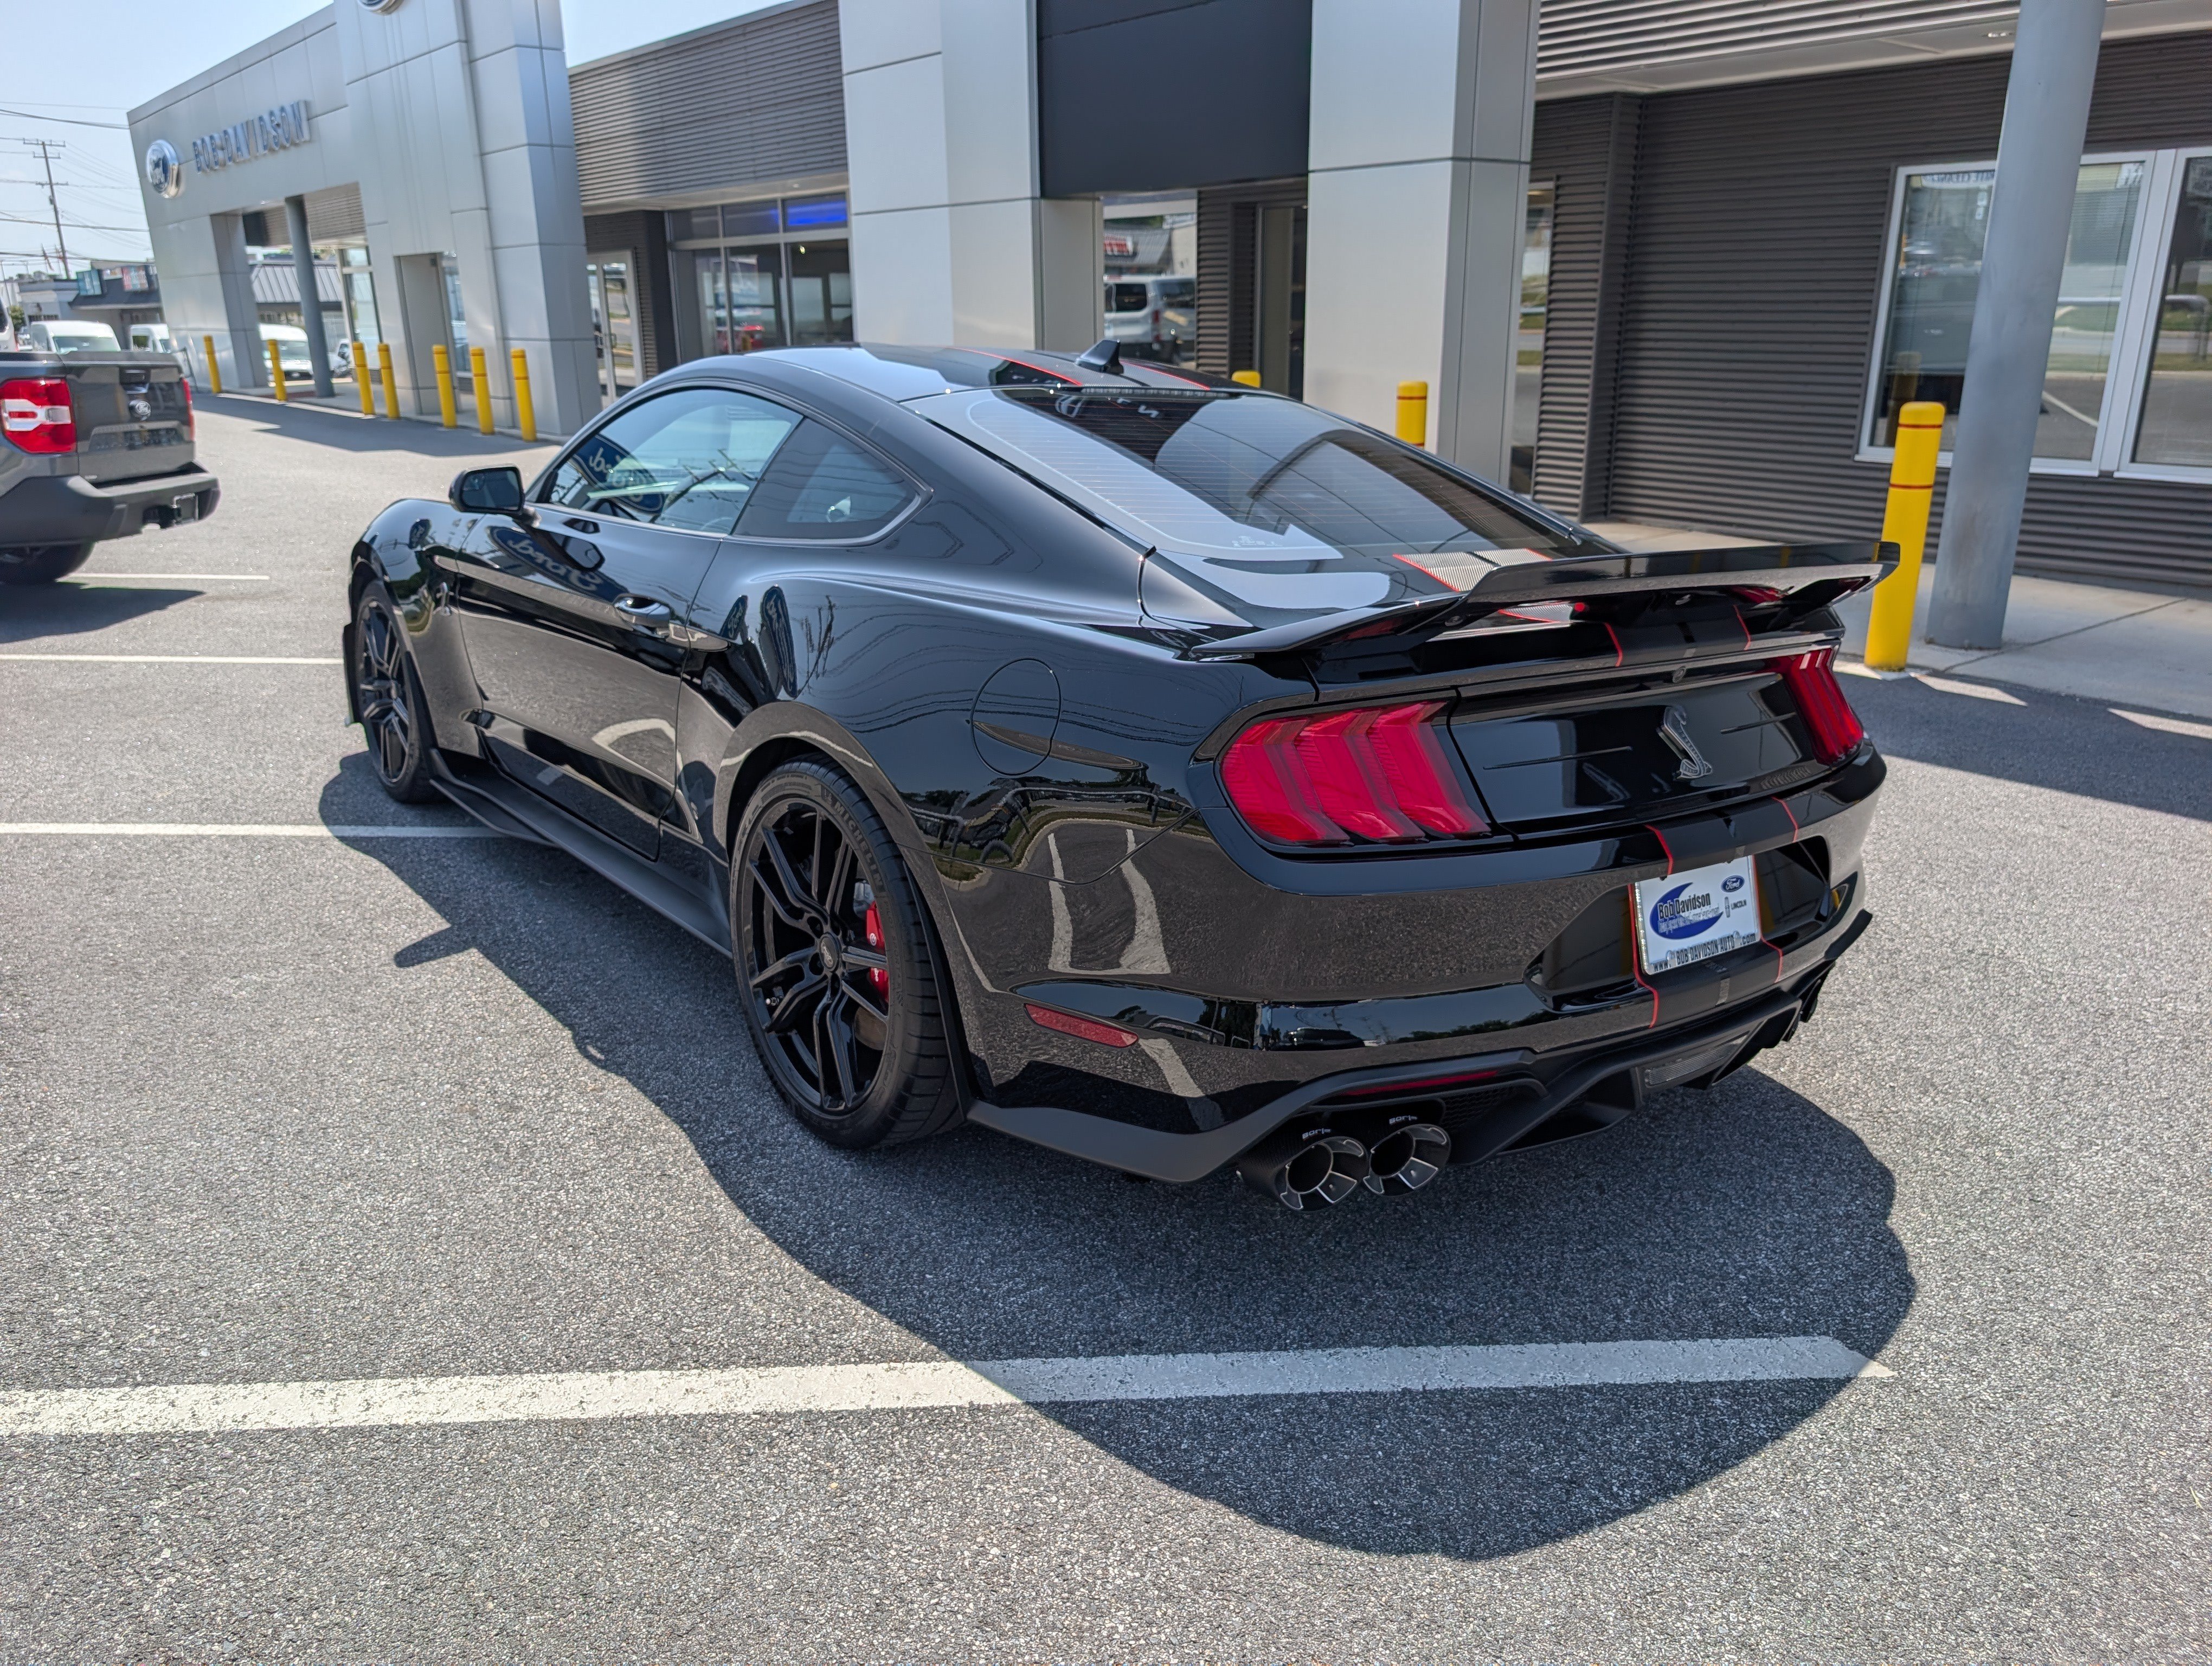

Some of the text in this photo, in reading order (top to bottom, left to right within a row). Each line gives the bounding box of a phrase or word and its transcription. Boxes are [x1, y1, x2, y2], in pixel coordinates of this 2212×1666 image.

[192, 99, 311, 174] BOB DAVIDSON
[833, 799, 884, 887] MICHELIN
[1725, 877, 1741, 891] Ford
[1658, 899, 1675, 919] Bob
[1674, 893, 1711, 915] Davidson
[1731, 899, 1747, 911] LINCOLN
[1676, 949, 1689, 965] BOB
[1689, 941, 1719, 960] DAVIDSON
[1719, 934, 1735, 952] AUTO
